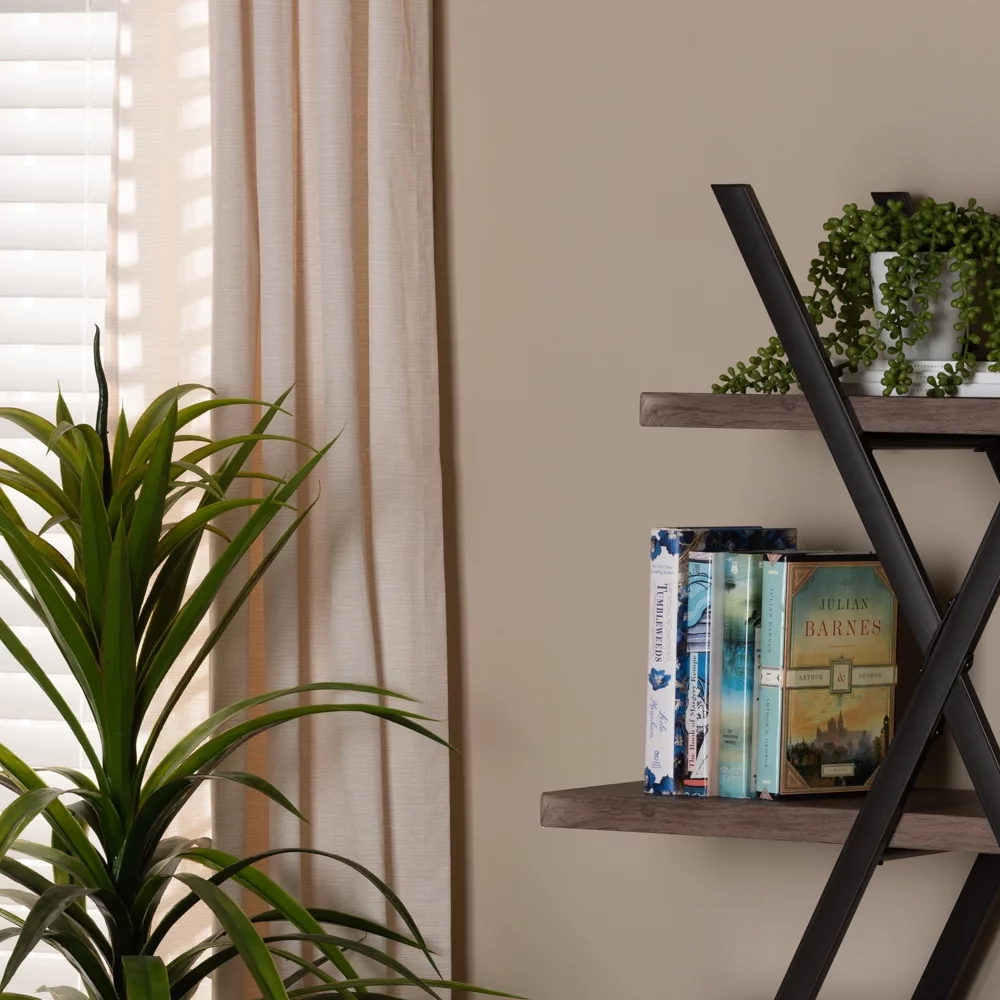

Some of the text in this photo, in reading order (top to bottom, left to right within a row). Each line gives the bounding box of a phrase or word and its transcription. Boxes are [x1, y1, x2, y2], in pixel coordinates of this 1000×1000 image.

[818, 597, 870, 611] JULIAN
[654, 582, 668, 663] TUMBLEWEEDS
[804, 619, 882, 637] BARNES
[690, 655, 698, 683] Kempe
[799, 673, 823, 681] ARTHUR
[836, 671, 847, 683] &
[689, 686, 698, 717] Margery
[648, 696, 659, 739] Meacham
[657, 709, 669, 734] Leila
[691, 719, 696, 729] of
